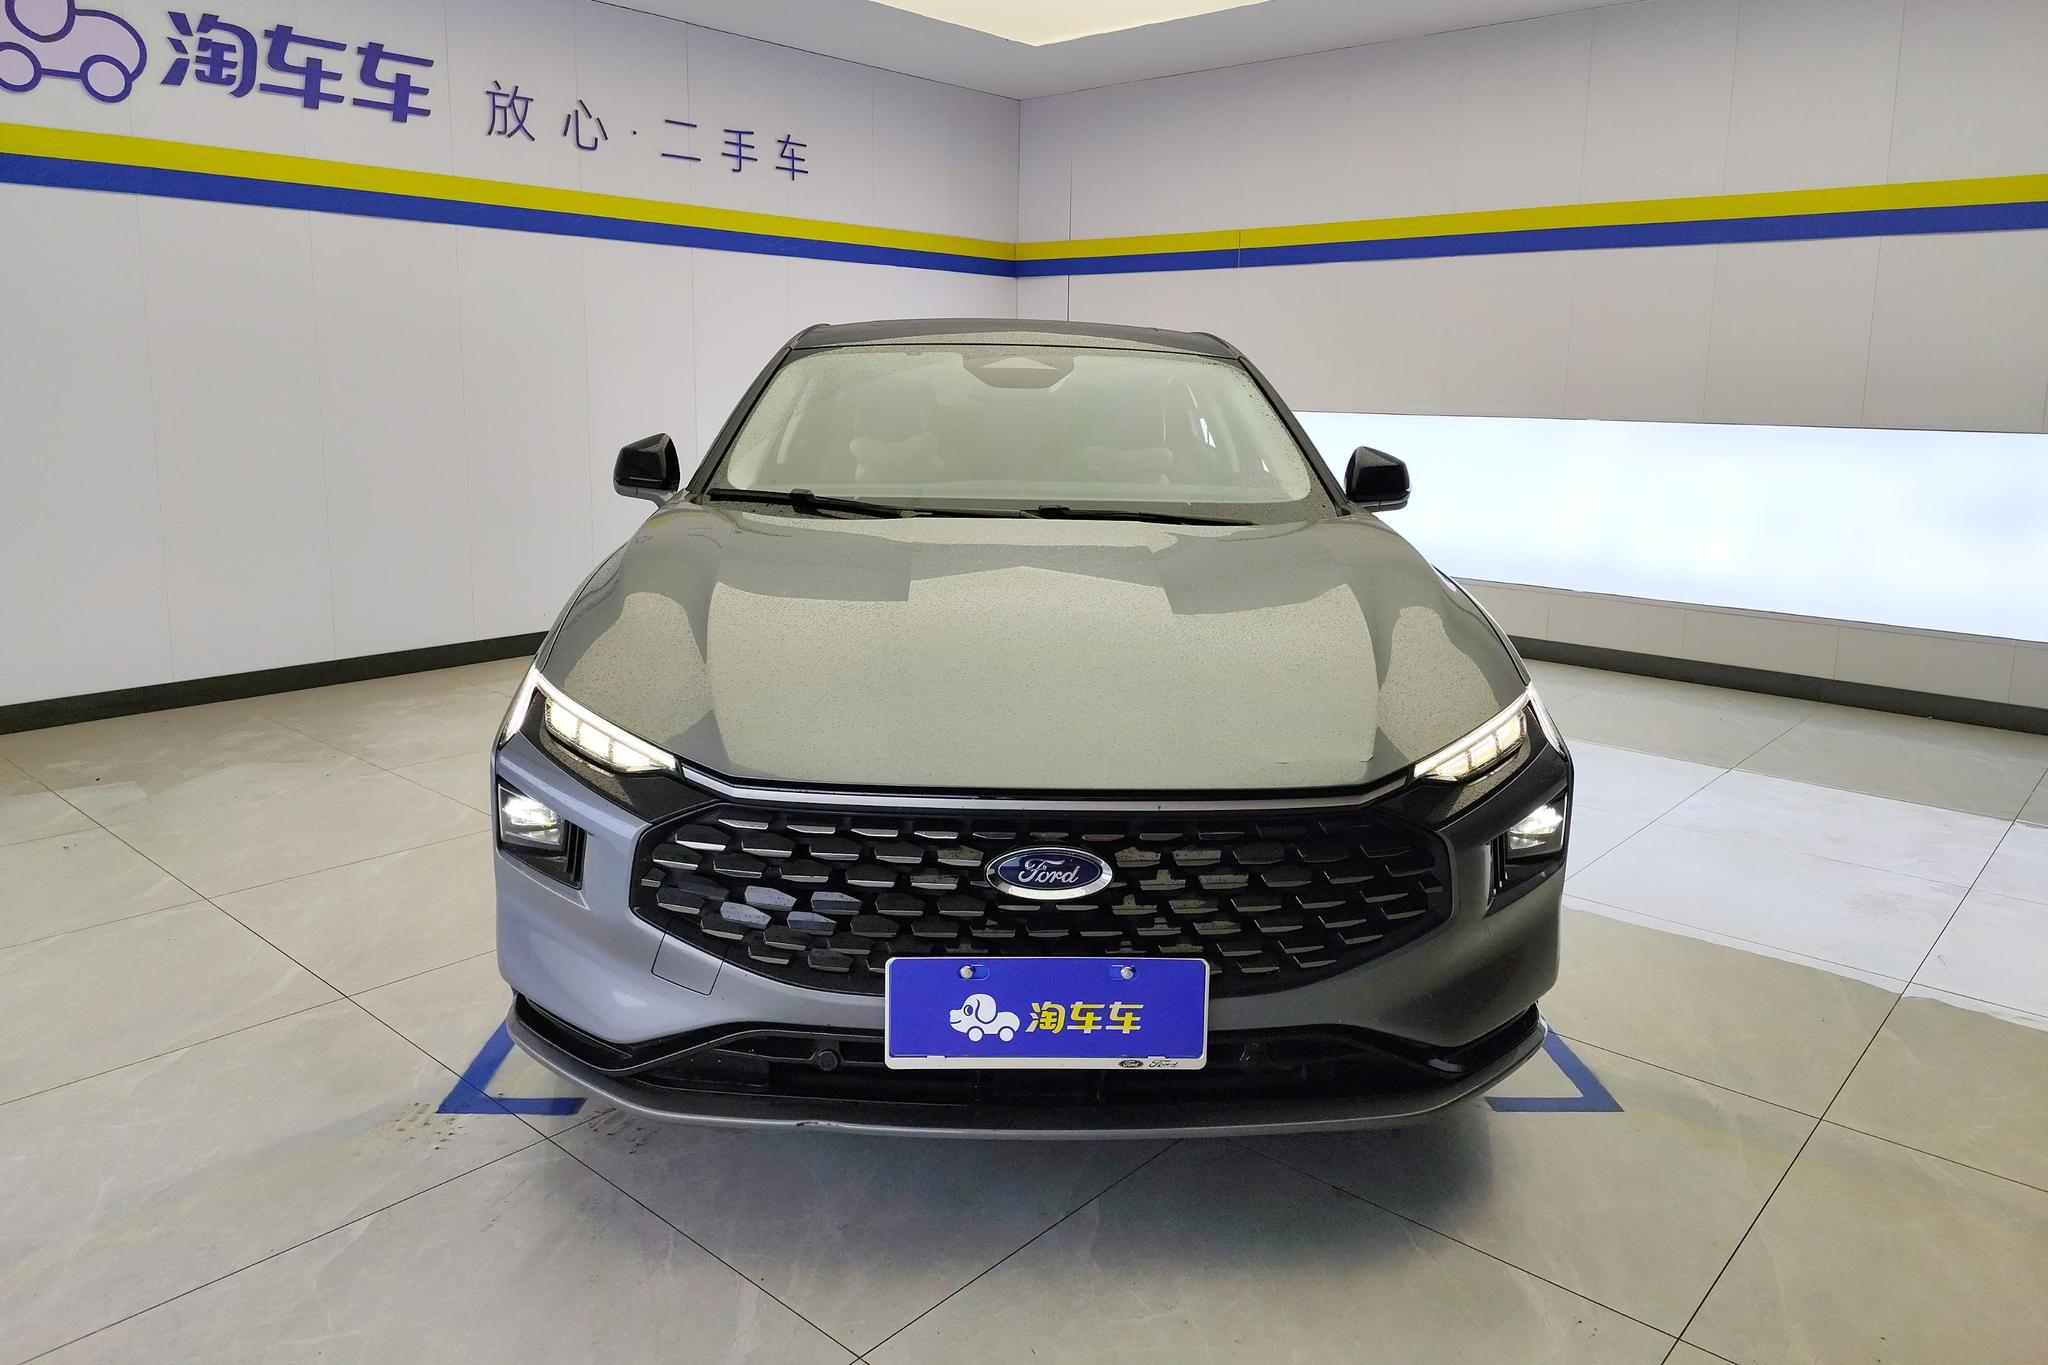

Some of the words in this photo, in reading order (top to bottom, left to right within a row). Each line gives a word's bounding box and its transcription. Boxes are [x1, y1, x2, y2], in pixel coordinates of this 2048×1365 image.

[160, 12, 435, 123] 淘车车
[1018, 858, 1080, 883] Ford
[1025, 1001, 1144, 1034] 淘车车
